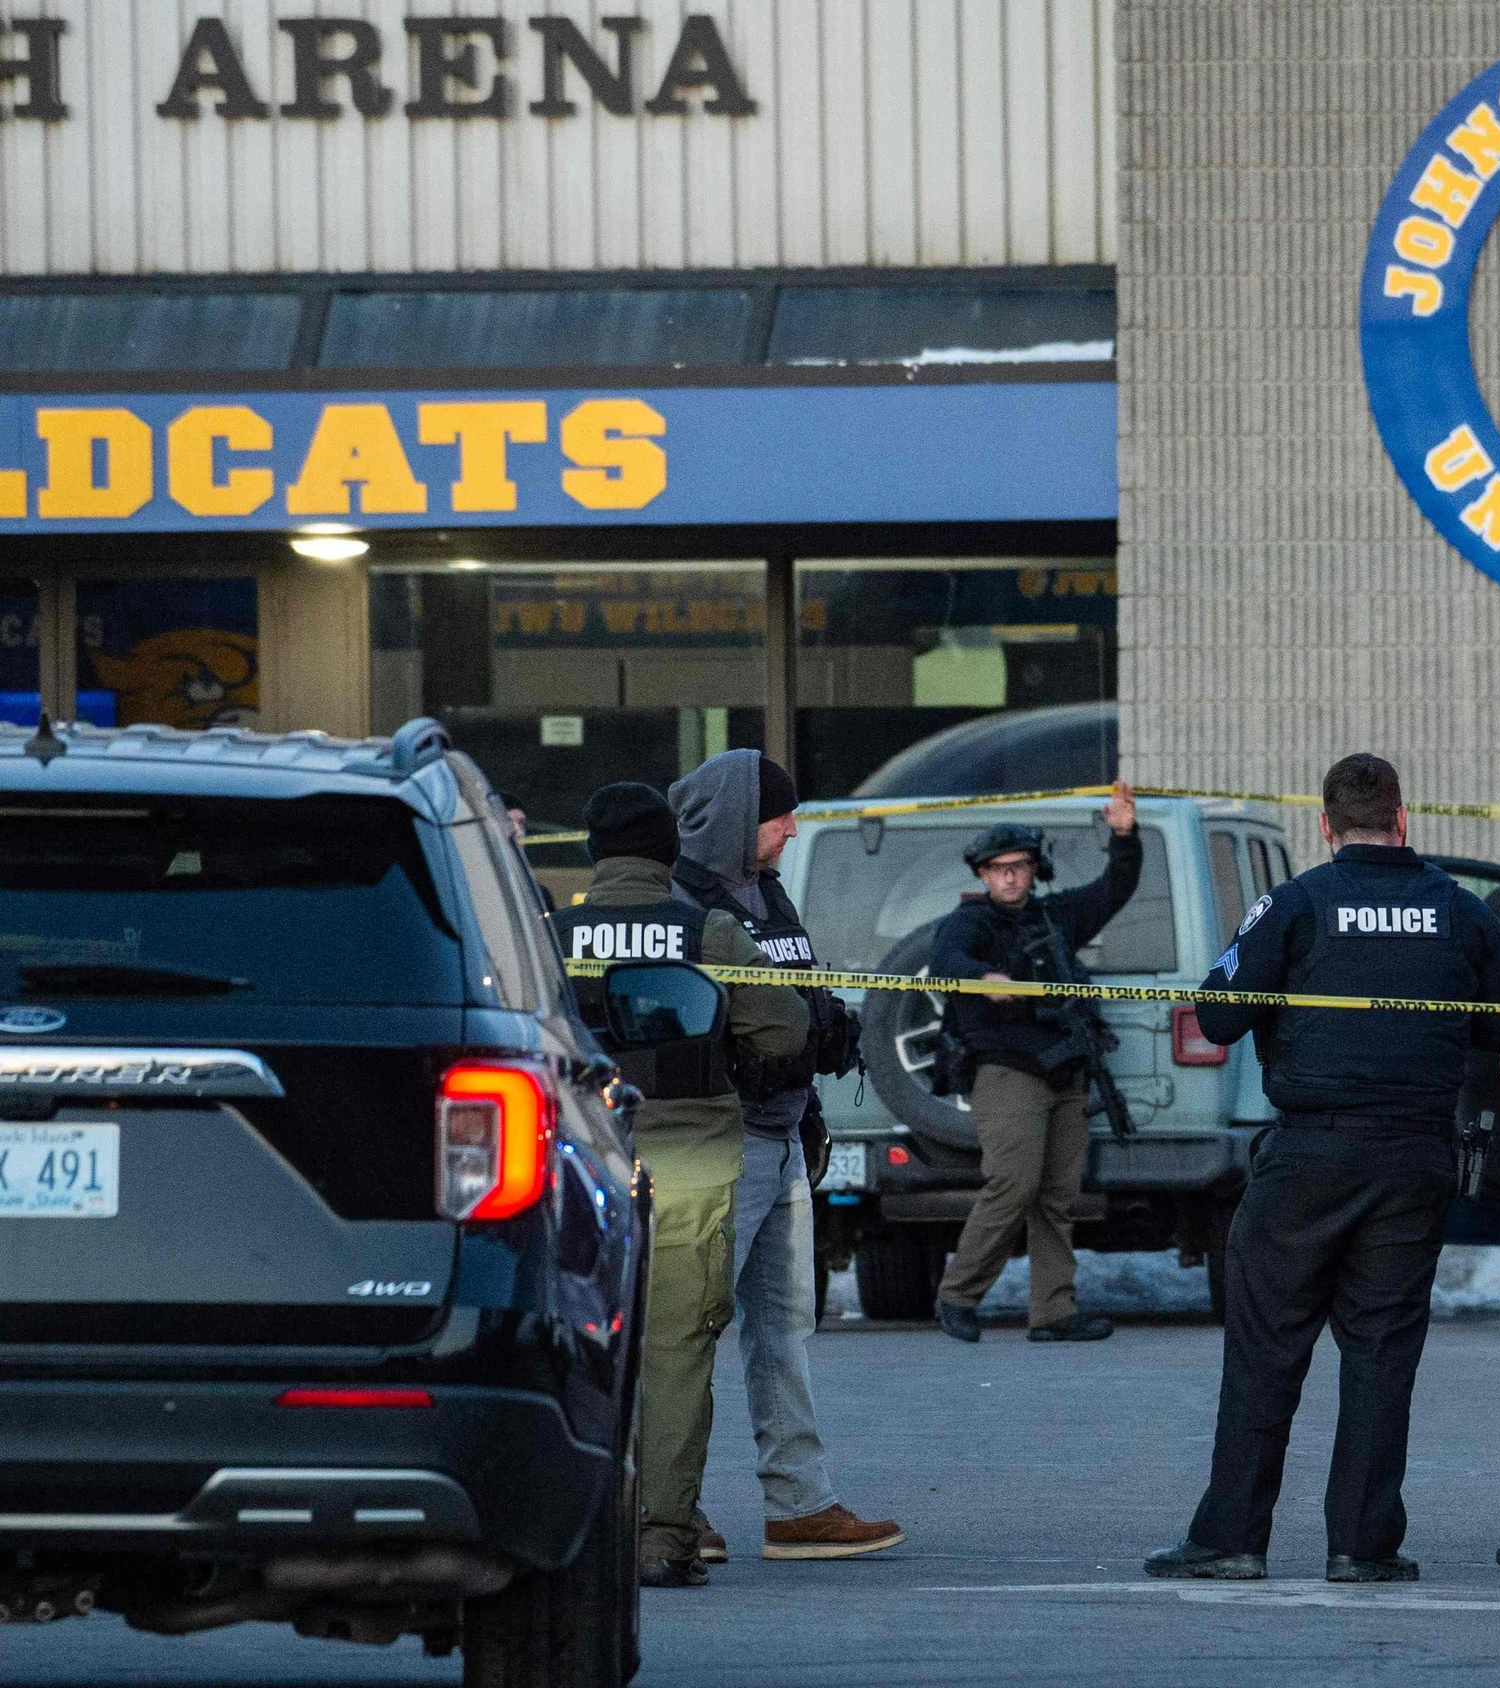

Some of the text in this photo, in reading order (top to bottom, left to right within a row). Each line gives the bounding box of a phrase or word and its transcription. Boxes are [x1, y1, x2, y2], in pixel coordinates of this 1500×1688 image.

[156, 14, 759, 120] ARENA
[0, 399, 667, 520] DCATS
[1338, 907, 1437, 933] POLICE
[573, 923, 684, 960] POLICE
[755, 938, 799, 963] OLICE
[39, 1150, 103, 1192] 491
[347, 1280, 432, 1296] 4WD
